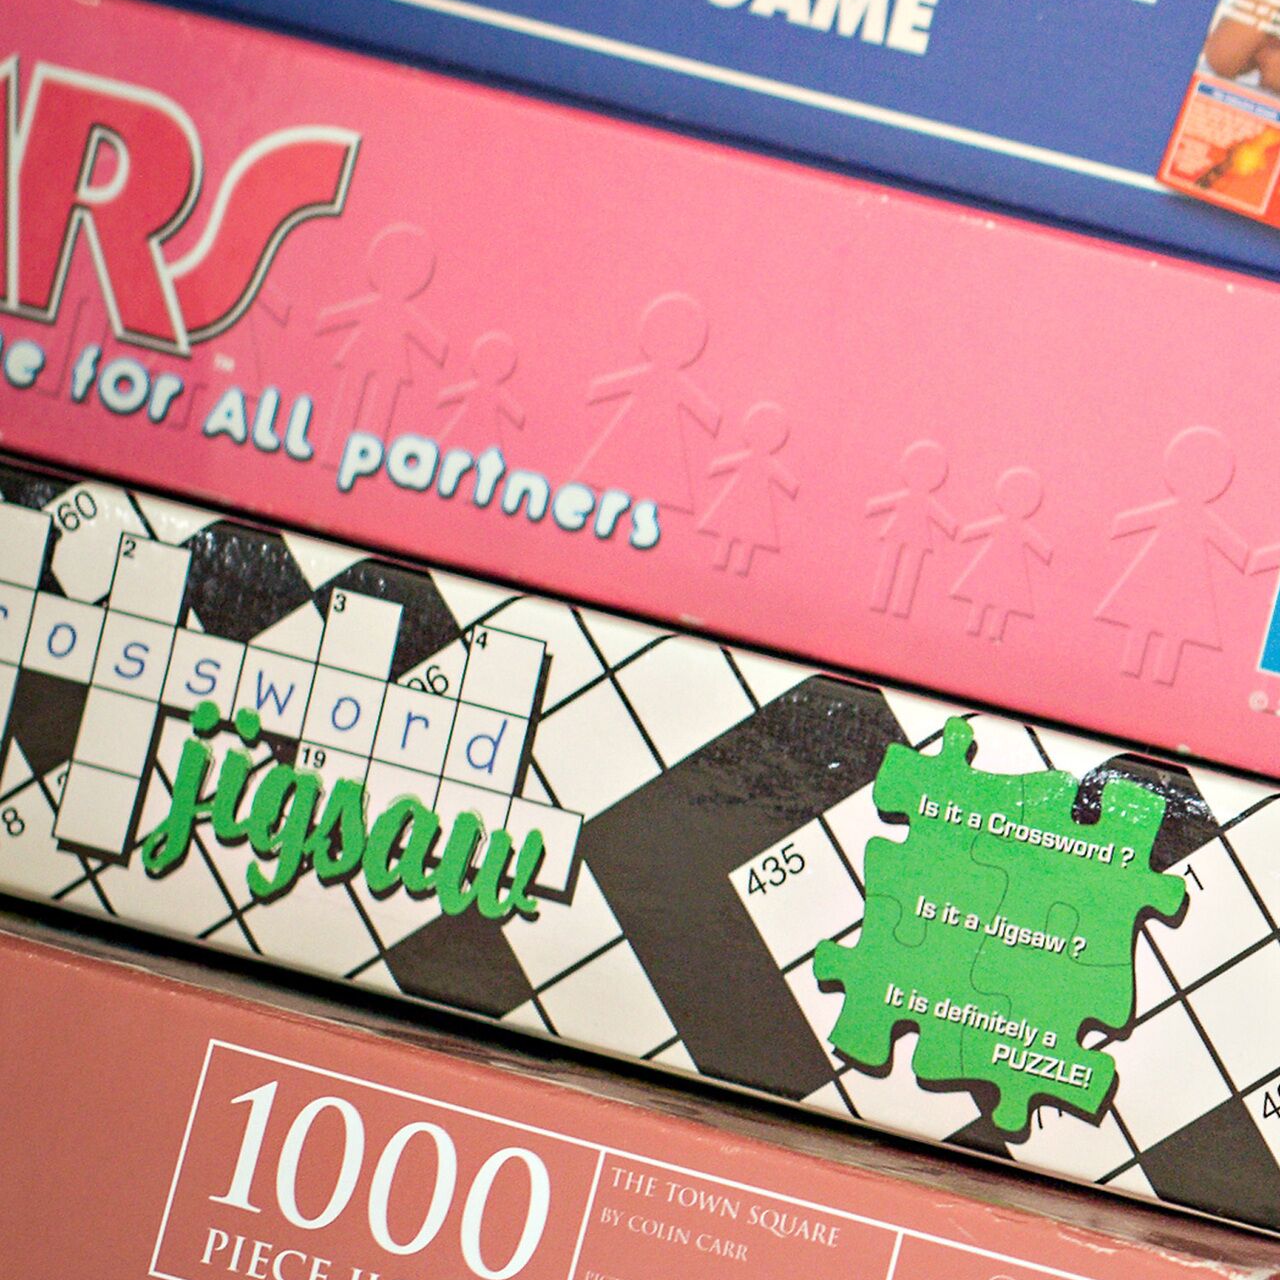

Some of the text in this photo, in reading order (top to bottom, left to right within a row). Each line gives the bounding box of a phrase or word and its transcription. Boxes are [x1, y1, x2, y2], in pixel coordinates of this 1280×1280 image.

[72, 345, 183, 423] for
[203, 387, 313, 460] ALL
[338, 432, 661, 552] partners
[142, 700, 545, 920] jigsaw
[918, 794, 1117, 866] Is it a Crossword
[746, 843, 806, 898] 435
[914, 895, 1068, 957] Is it a Jigsaw
[884, 982, 1058, 1049] It is definitely a
[992, 1042, 1094, 1091] PUZZLE!
[600, 1206, 749, 1262] BY COLIN CARR
[611, 1166, 842, 1248] THE TOWN SQUARE
